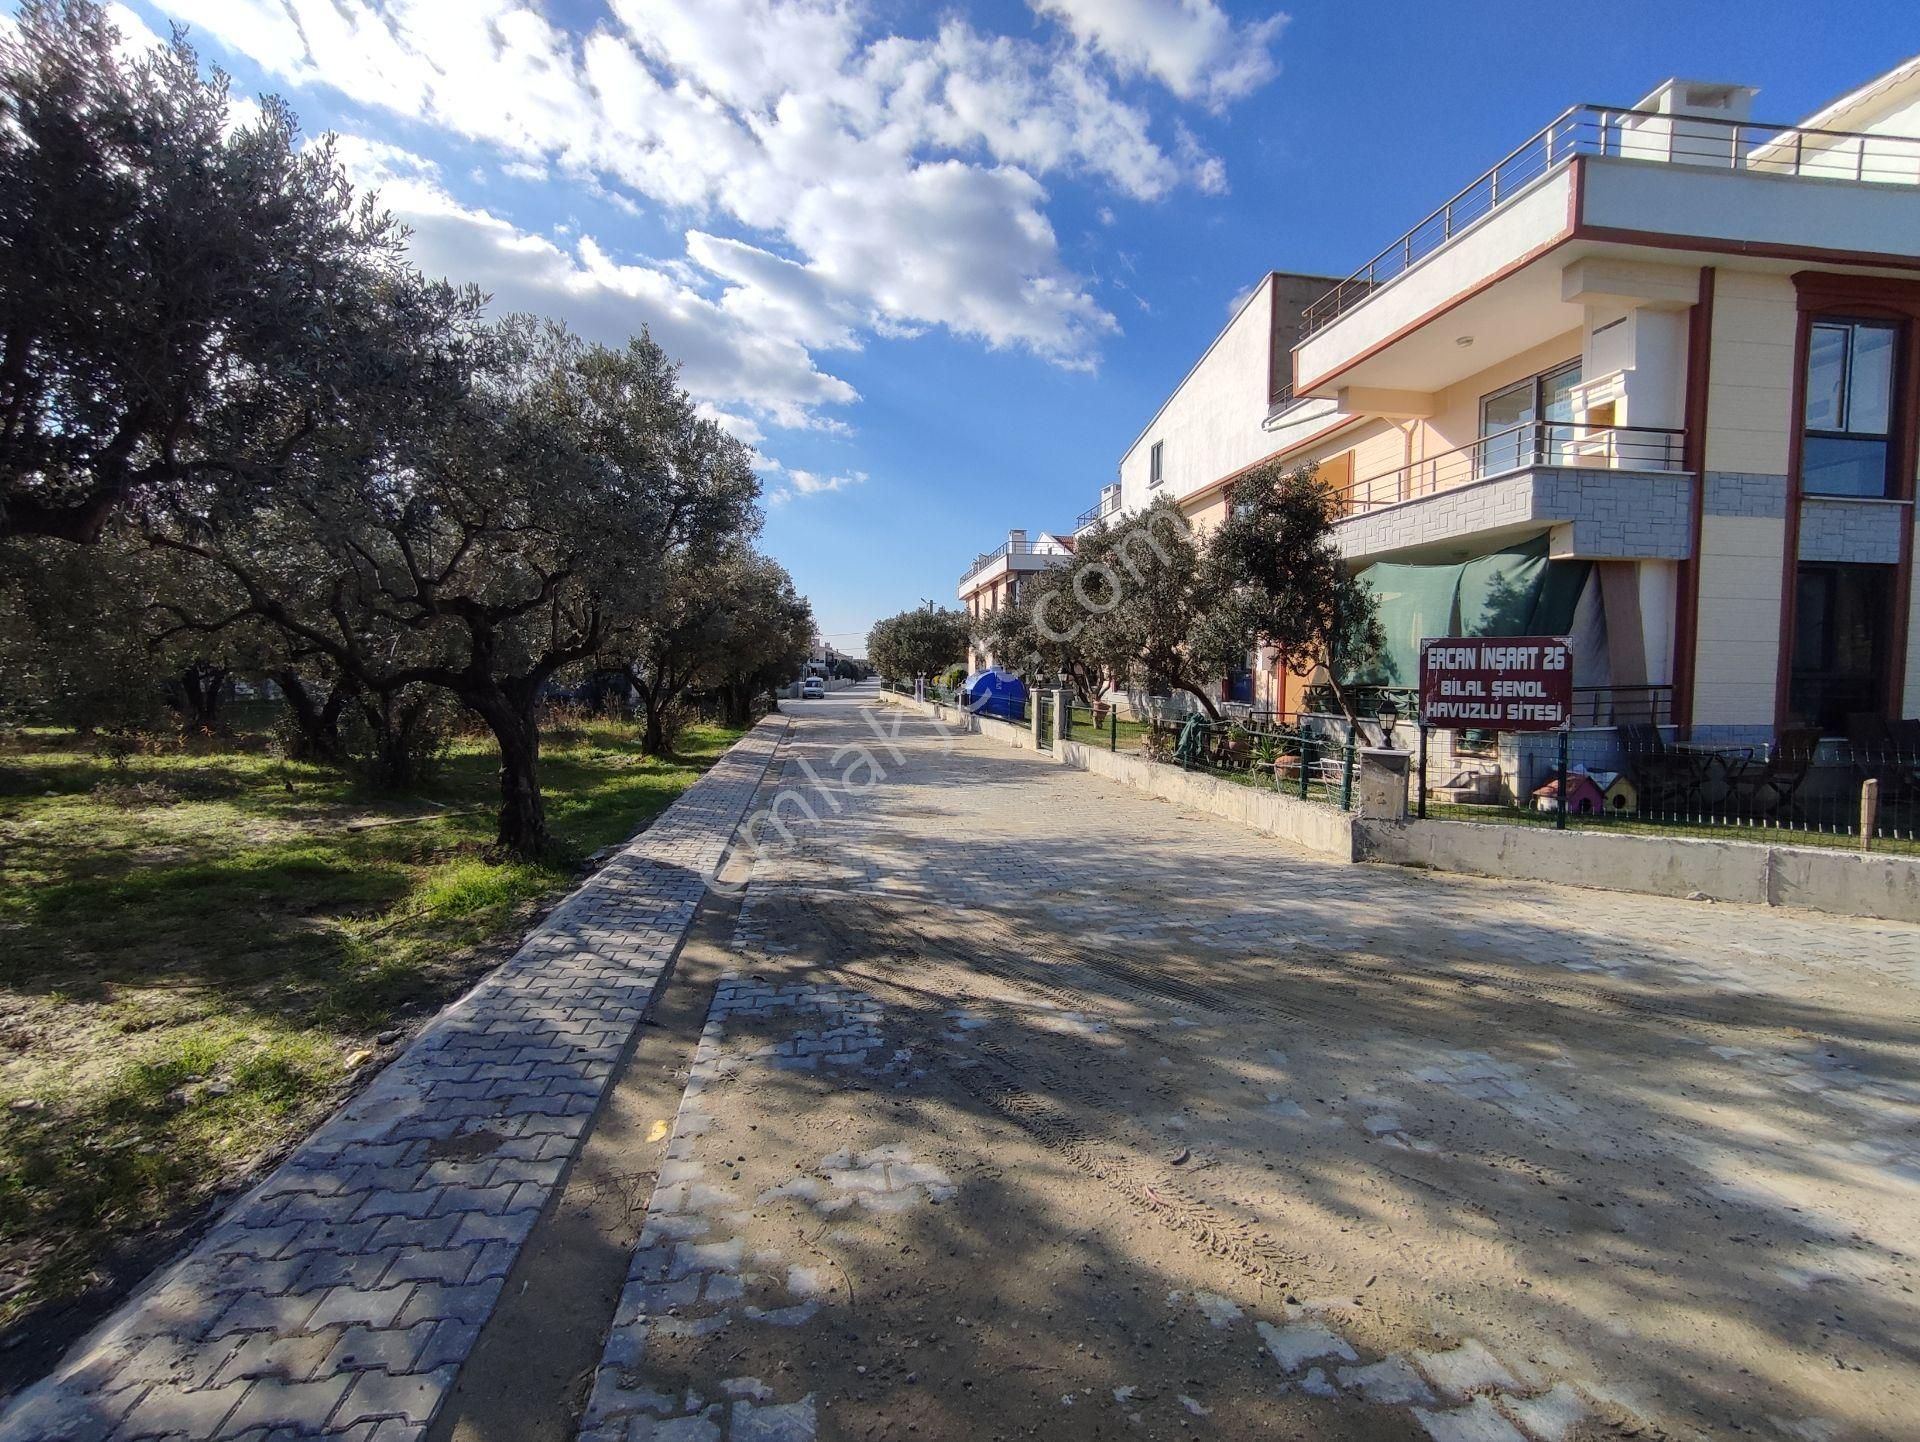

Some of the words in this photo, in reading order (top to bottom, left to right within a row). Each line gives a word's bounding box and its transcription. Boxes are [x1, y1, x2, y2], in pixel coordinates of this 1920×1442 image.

[1427, 647, 1476, 670] ERCAN
[1480, 643, 1539, 676] İNŞAAT
[1542, 647, 1566, 670] 26
[1440, 677, 1487, 697] BİLAL
[1491, 680, 1547, 701] ŞENOL
[1426, 701, 1501, 720] HAVUZLU
[1506, 701, 1562, 721] SİTESİ
